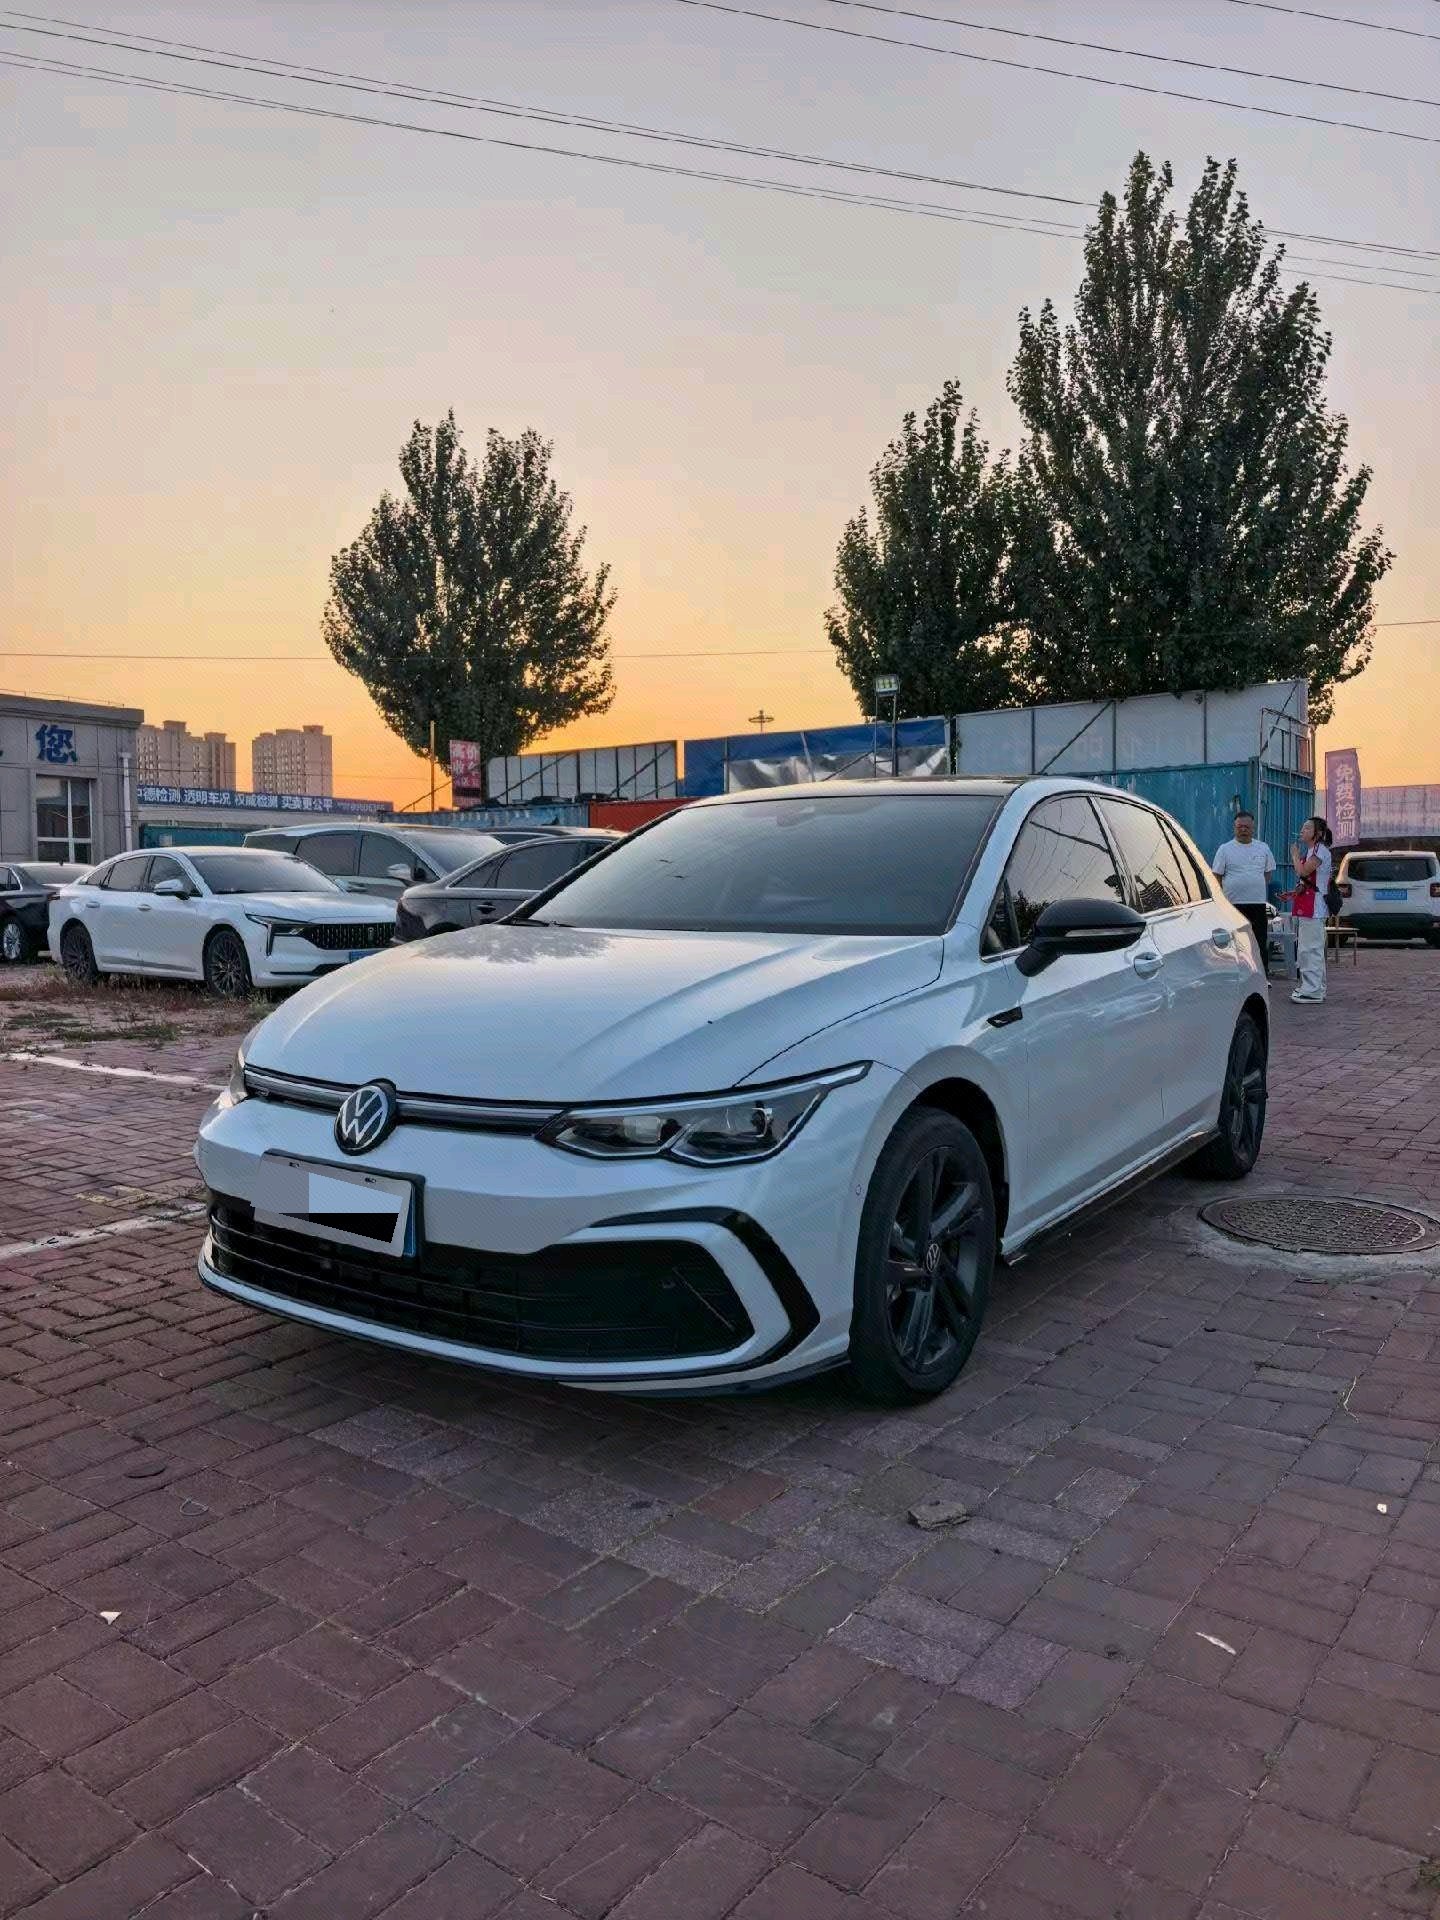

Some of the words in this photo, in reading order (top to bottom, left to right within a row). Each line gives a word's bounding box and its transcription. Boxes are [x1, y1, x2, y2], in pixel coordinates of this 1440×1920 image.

[36, 724, 78, 763] 您
[183, 789, 231, 805] 透明车况
[234, 792, 278, 808] 权威检测
[281, 795, 333, 812] 买卖更公平
[340, 1084, 389, 1150] VW
